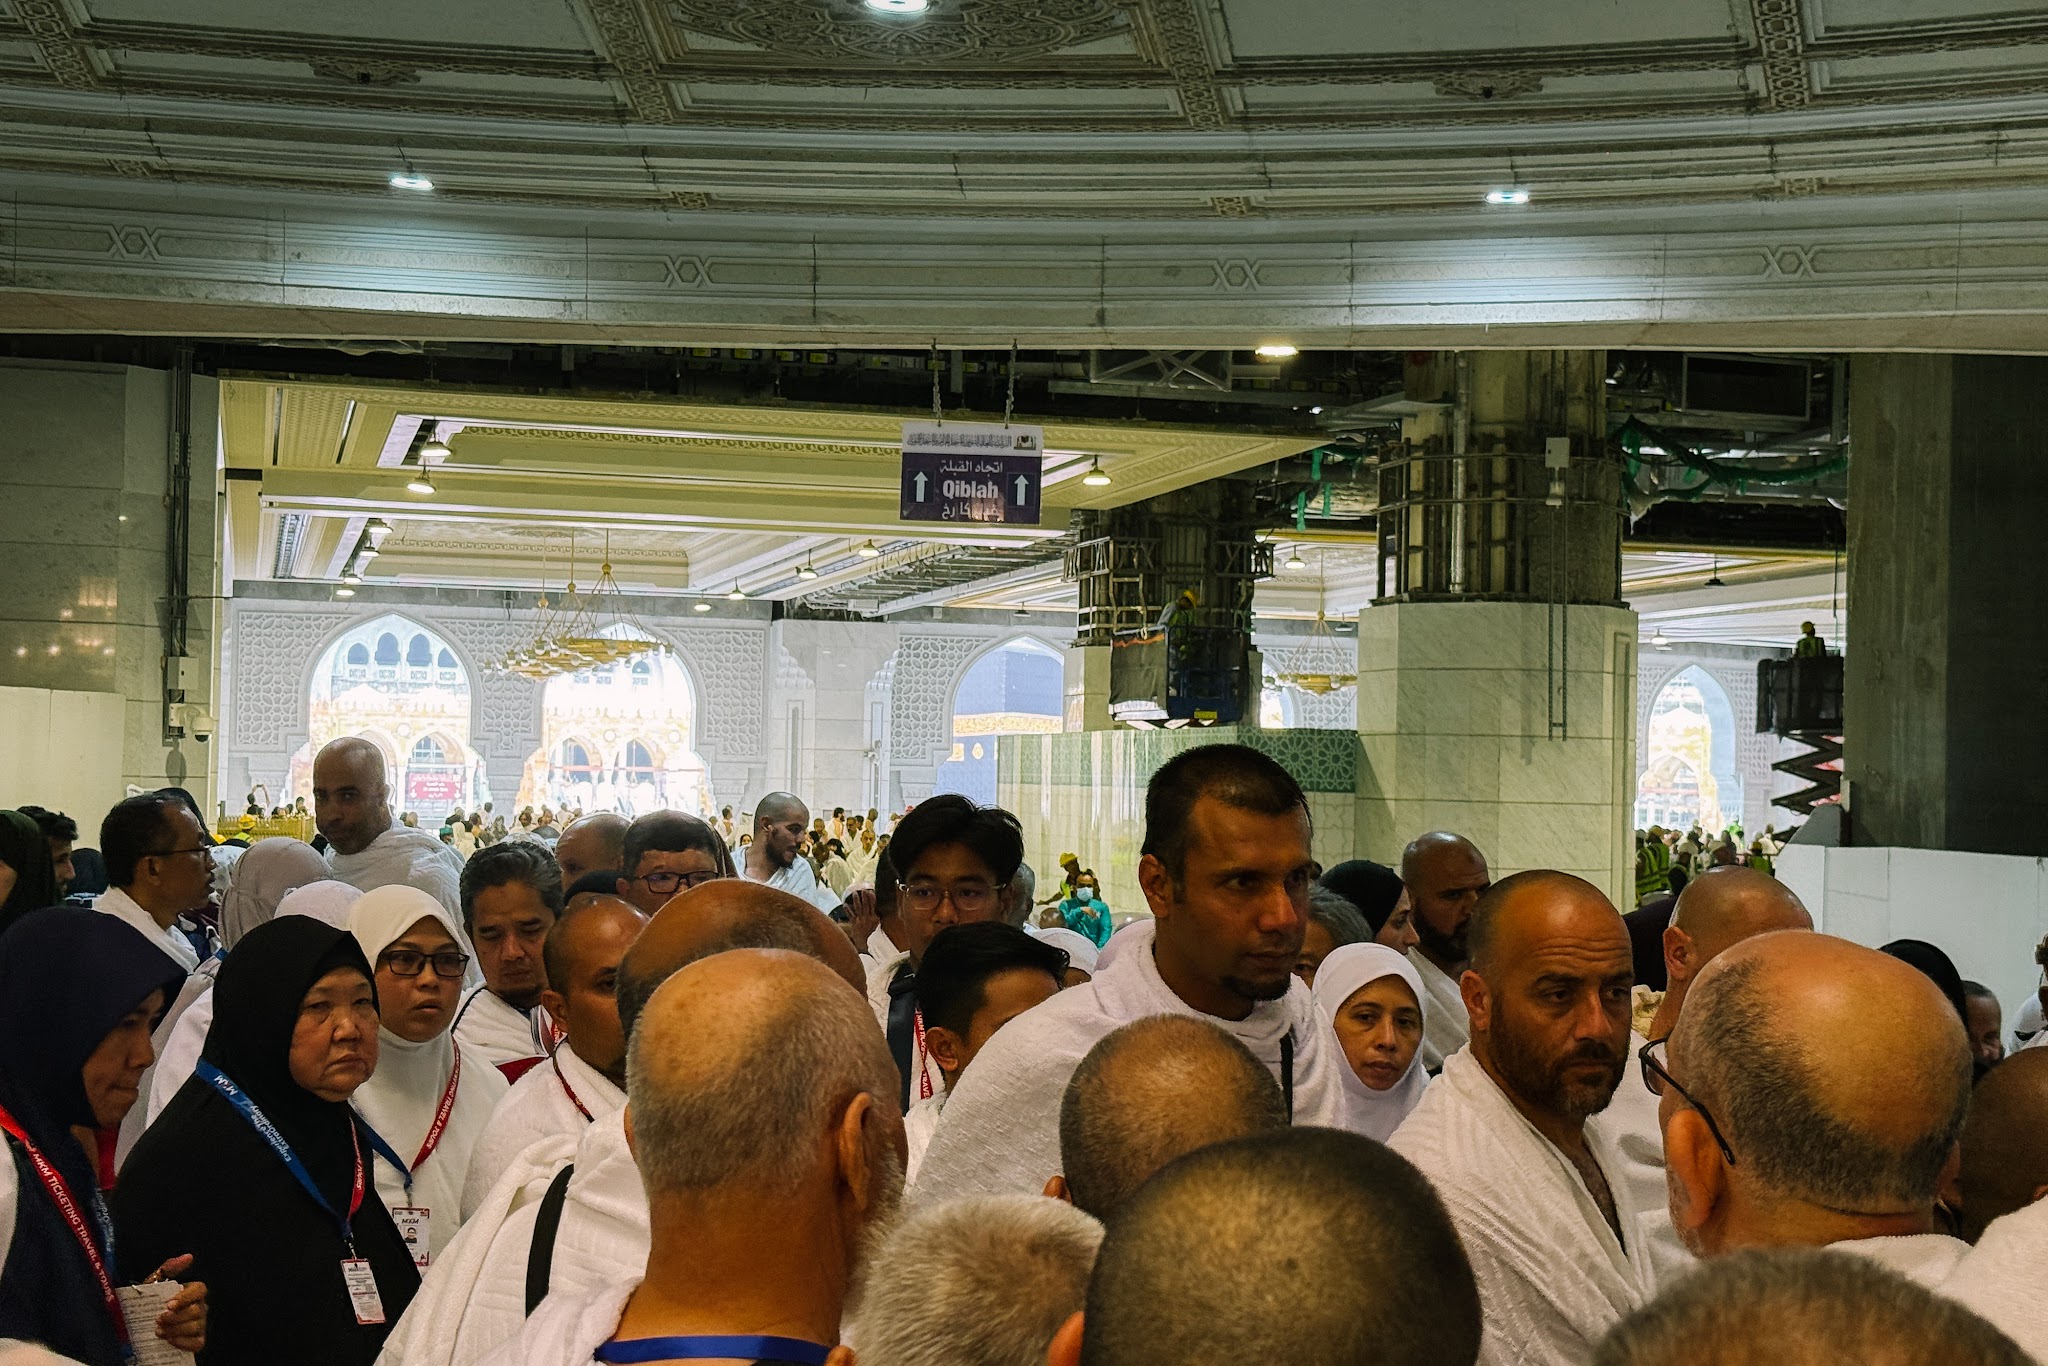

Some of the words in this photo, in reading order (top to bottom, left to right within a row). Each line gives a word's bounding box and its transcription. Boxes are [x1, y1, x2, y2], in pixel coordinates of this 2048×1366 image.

[939, 459, 973, 476] القبلة
[974, 460, 1003, 477] اتجاه
[942, 479, 999, 500] Qiblah
[438, 1097, 452, 1121] TRAVEL
[250, 1105, 290, 1150] ExtraOrdinary
[426, 1128, 440, 1149] TOURS
[259, 1125, 292, 1162] Experience
[33, 1152, 51, 1177] MKM
[48, 1173, 81, 1226] TICKETING
[77, 1224, 97, 1262] TRAVEL
[99, 1270, 115, 1303] TOURS
